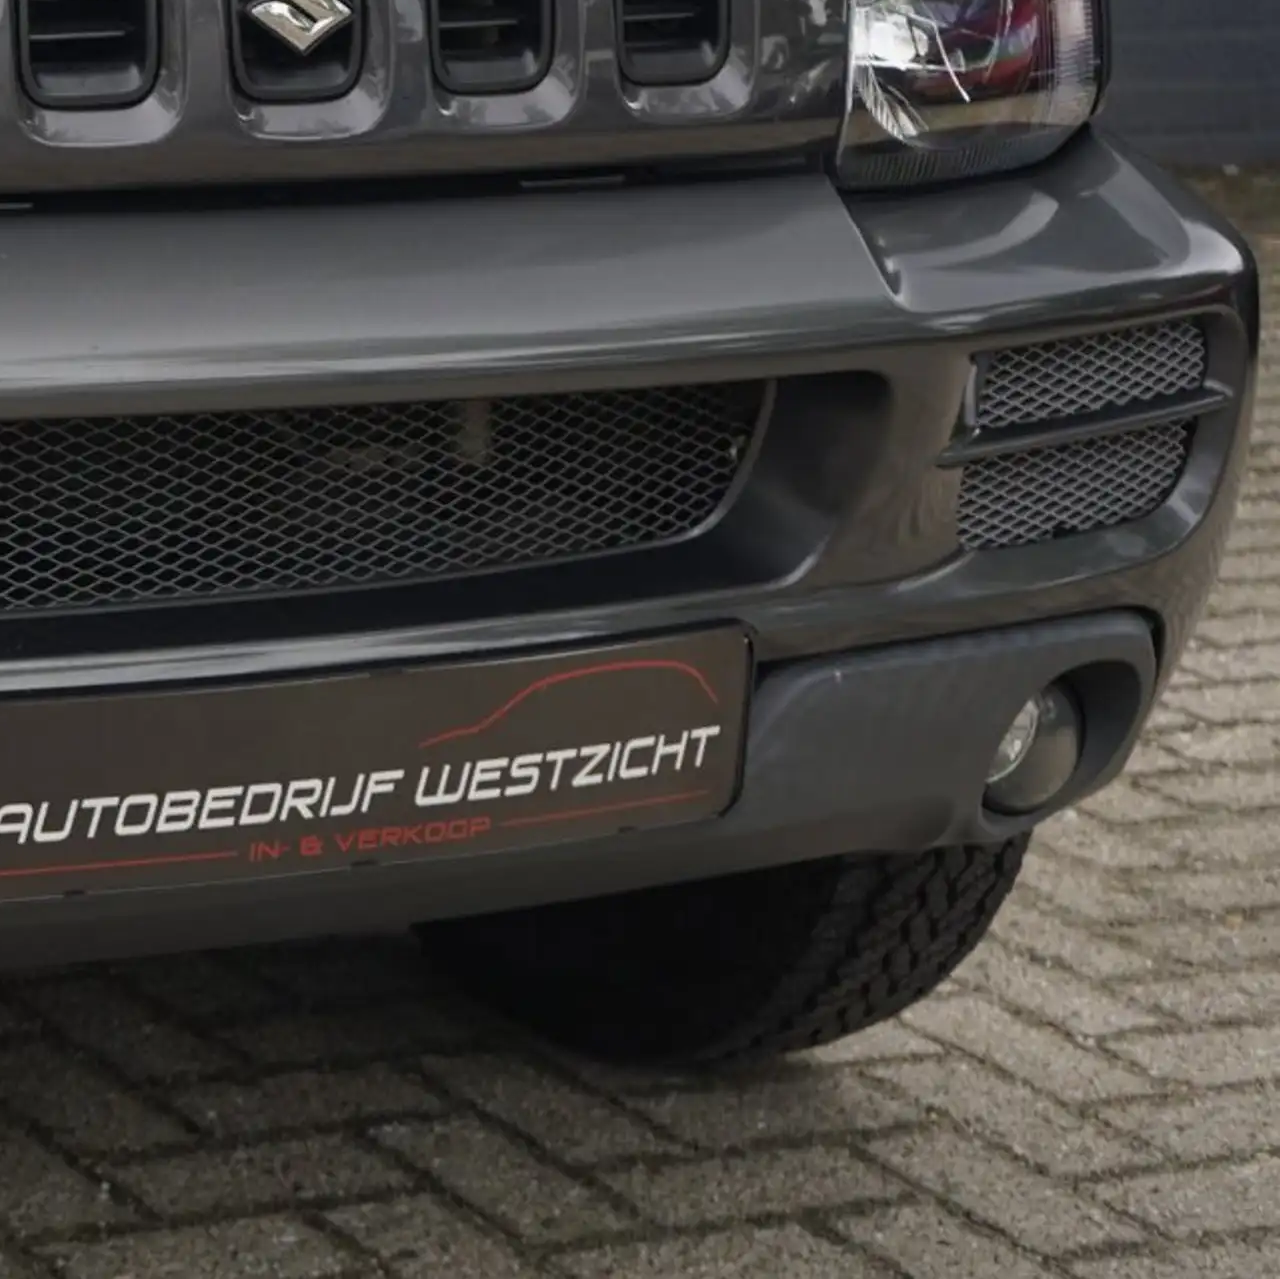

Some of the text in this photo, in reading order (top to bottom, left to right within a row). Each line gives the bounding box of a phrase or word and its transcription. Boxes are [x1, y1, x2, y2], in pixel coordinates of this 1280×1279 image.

[415, 726, 720, 807] WESTZICHT
[299, 835, 324, 856] &
[335, 817, 492, 853] VERKOOP
